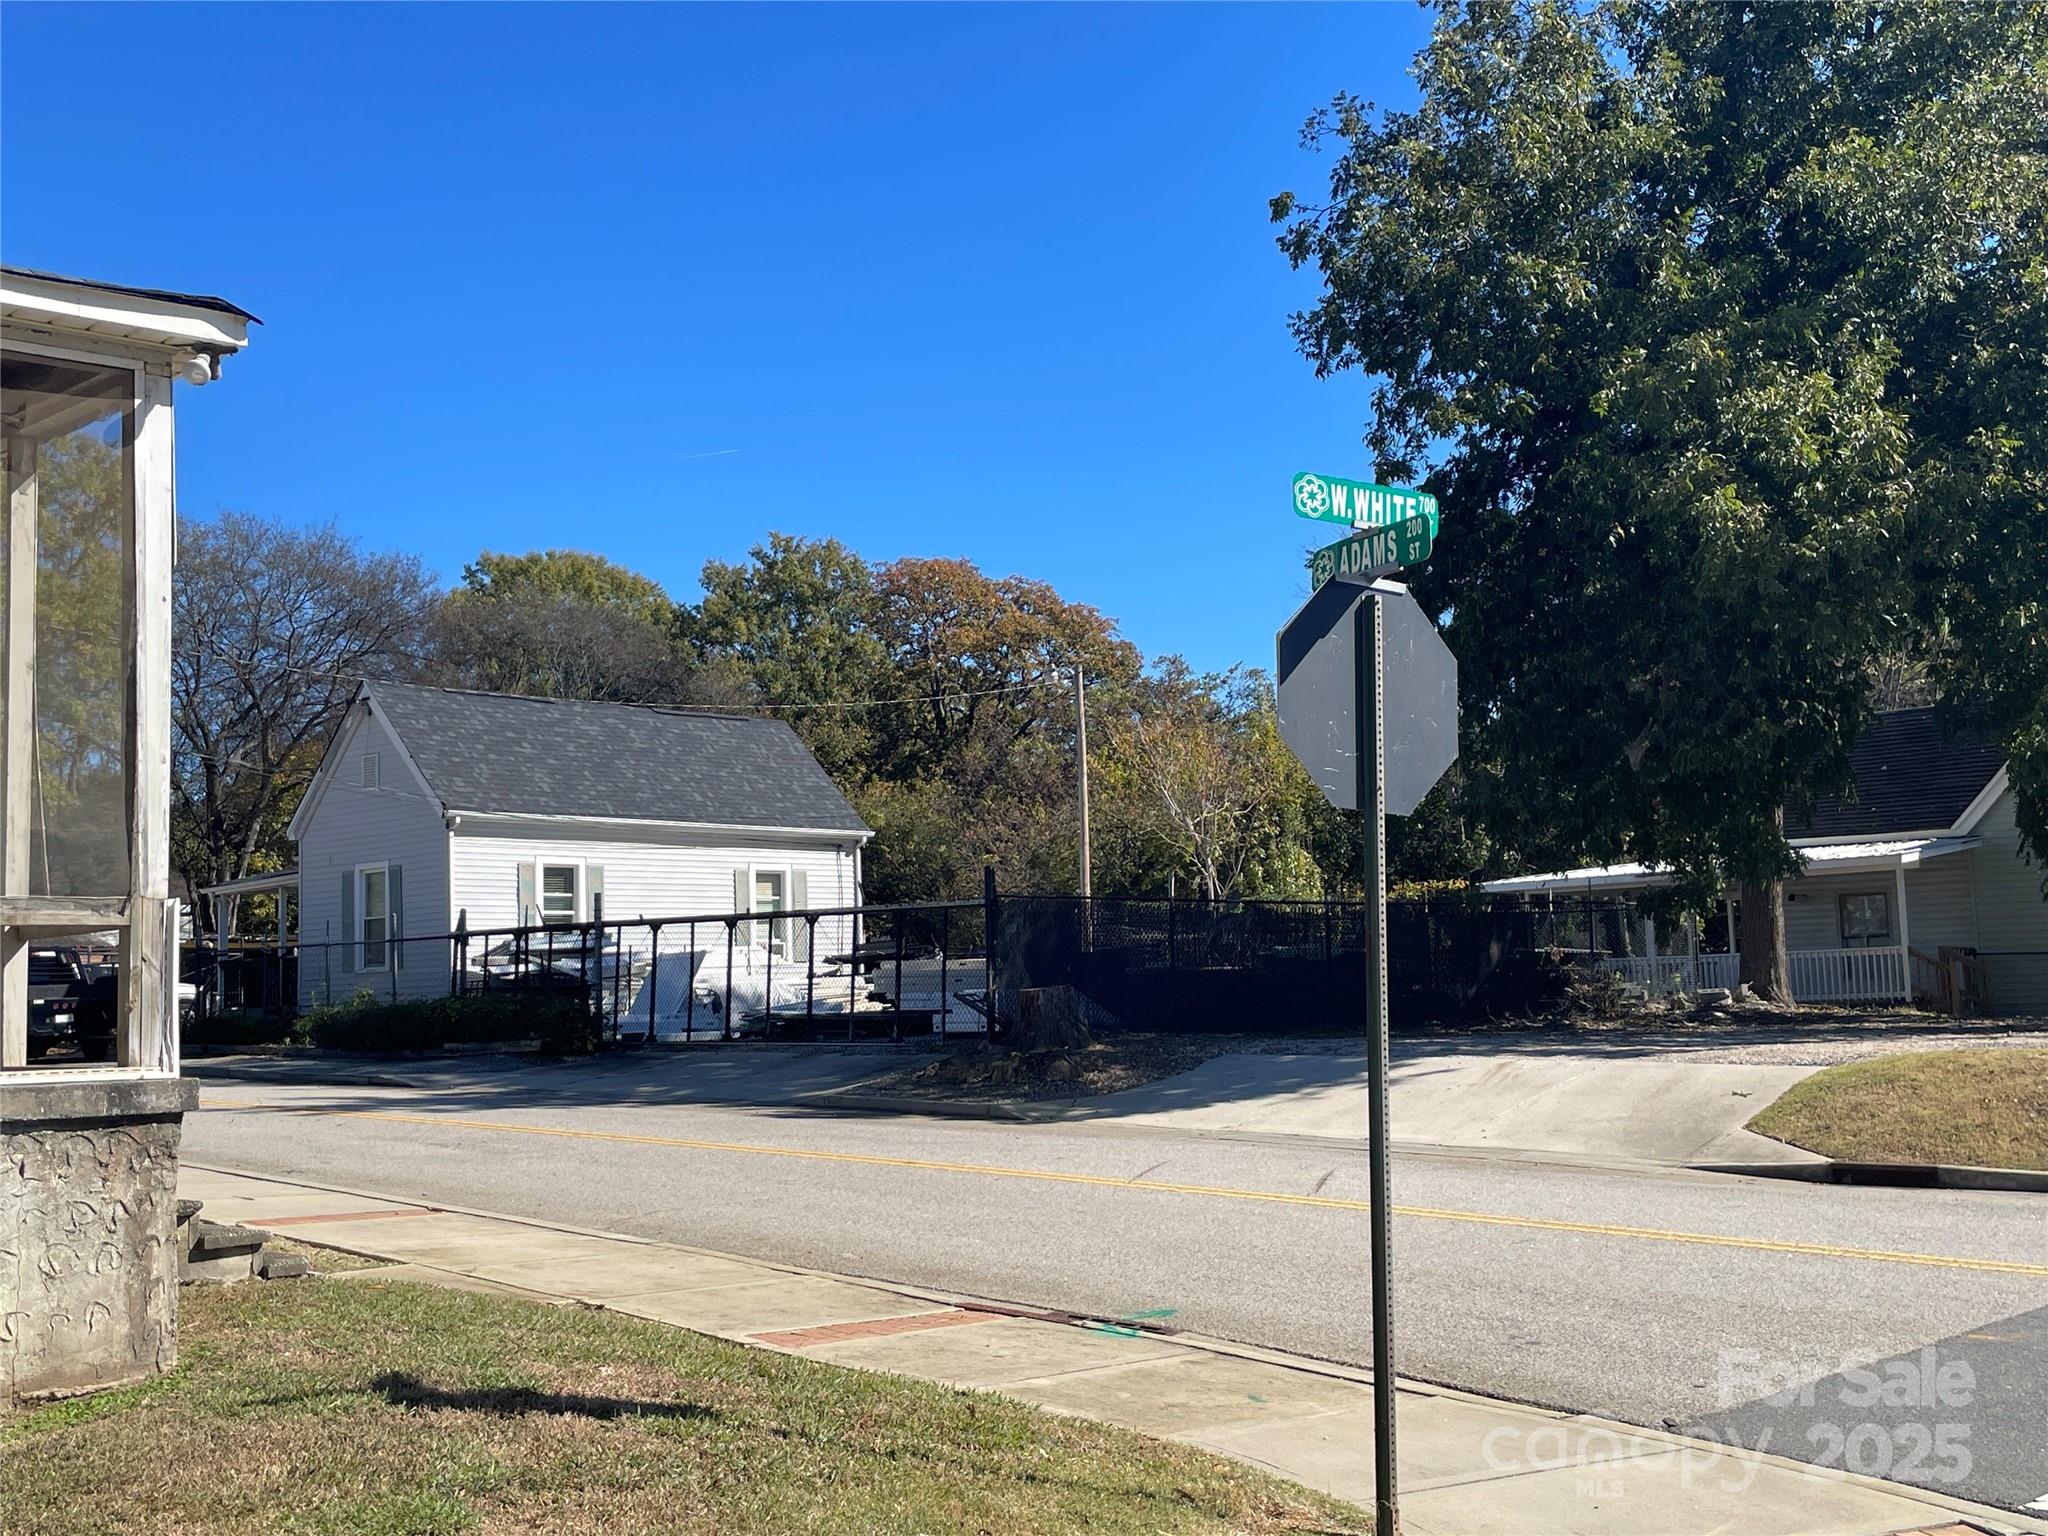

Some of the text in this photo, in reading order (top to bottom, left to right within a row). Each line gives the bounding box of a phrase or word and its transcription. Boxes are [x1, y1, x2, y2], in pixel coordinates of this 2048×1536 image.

[1419, 495, 1435, 514] 700
[1406, 517, 1423, 538] 200
[1340, 530, 1397, 574] ADAMS
[1409, 541, 1421, 561] ST
